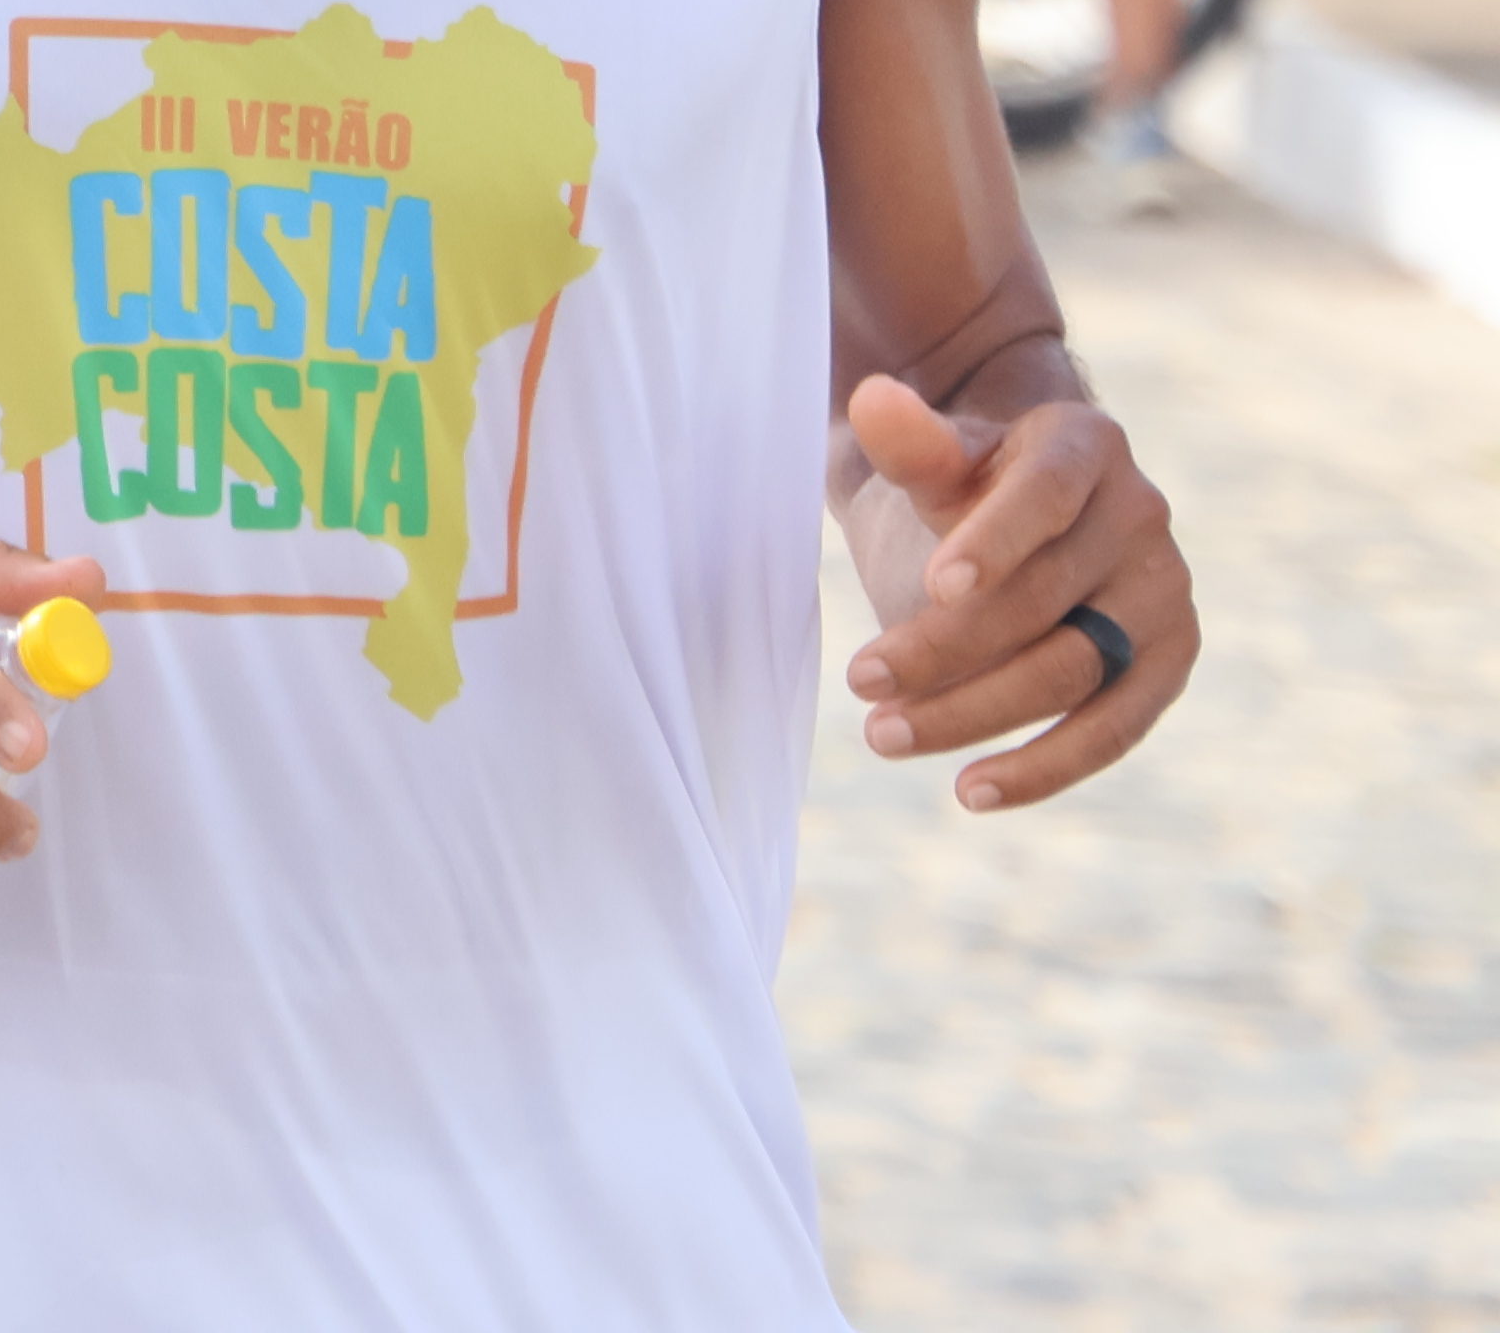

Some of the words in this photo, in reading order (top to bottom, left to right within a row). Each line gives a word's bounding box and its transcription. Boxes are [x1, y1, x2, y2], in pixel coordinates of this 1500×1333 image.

[141, 96, 195, 153] III
[227, 97, 412, 171] VERÃO
[69, 168, 438, 361] COSTA
[71, 347, 429, 538] COSTA
